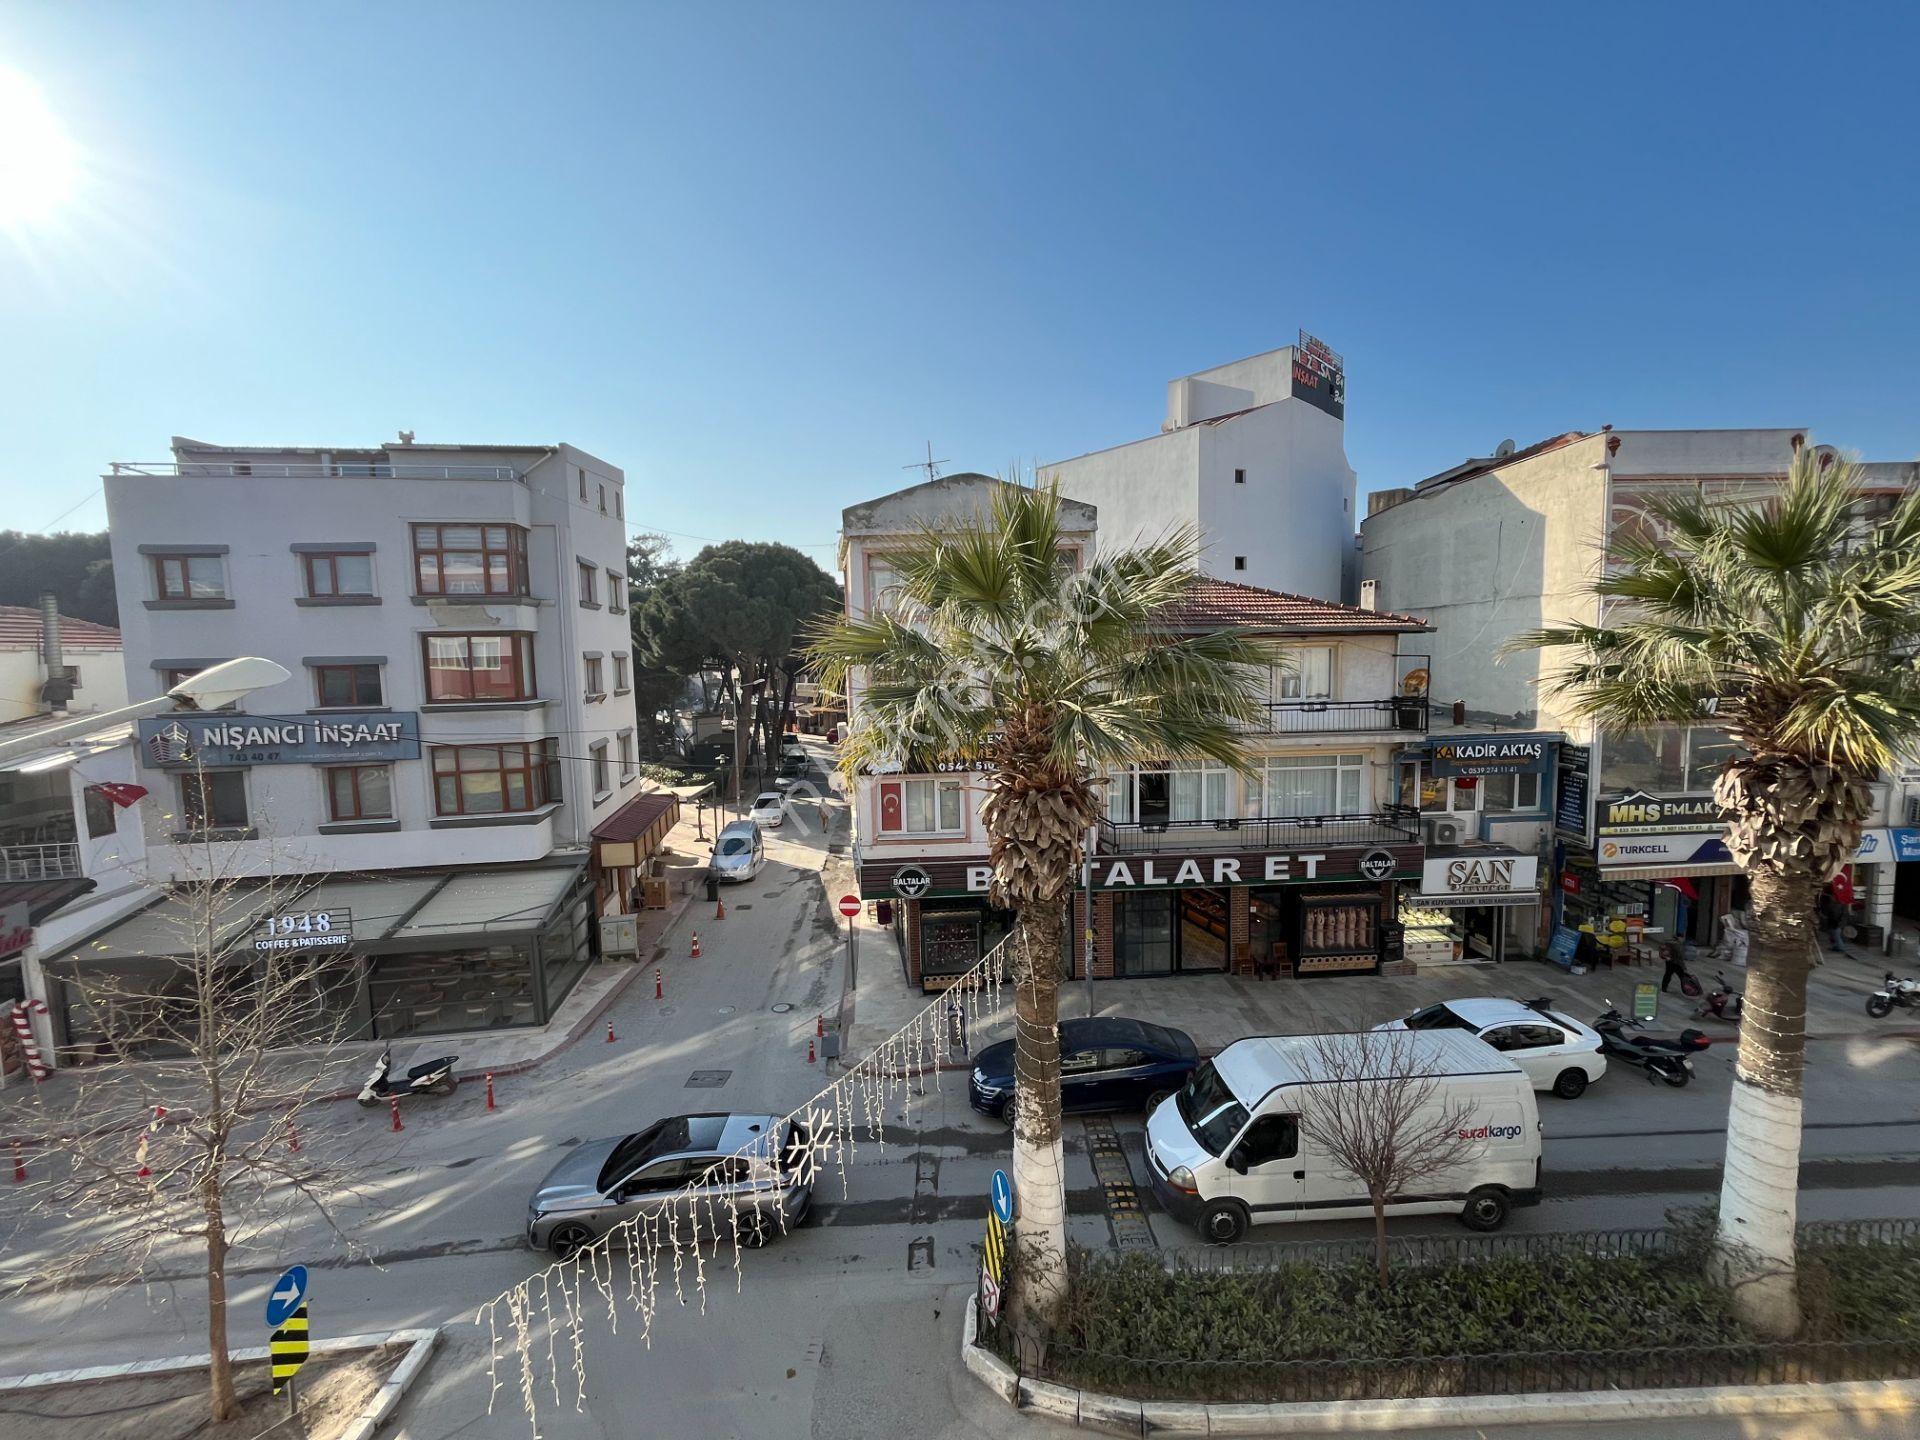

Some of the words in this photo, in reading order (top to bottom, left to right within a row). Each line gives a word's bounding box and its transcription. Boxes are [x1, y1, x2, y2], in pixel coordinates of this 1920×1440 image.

[203, 722, 304, 751] NİŞANCI
[314, 719, 402, 749] İNŞAAT
[1456, 743, 1497, 759] KADİR
[1500, 743, 1542, 759] AKTAŞ
[1608, 803, 1661, 823] MHS
[1663, 801, 1713, 816] EMLAK
[1619, 844, 1669, 855] TURKCELL
[1360, 858, 1397, 869] BALTALAR
[967, 857, 1242, 892] BTALAR
[1264, 854, 1326, 881] ET
[893, 876, 931, 887] BALTALAR
[267, 912, 331, 936] 1948
[255, 939, 290, 950] COFFEE
[299, 935, 348, 947] PATISSERIE
